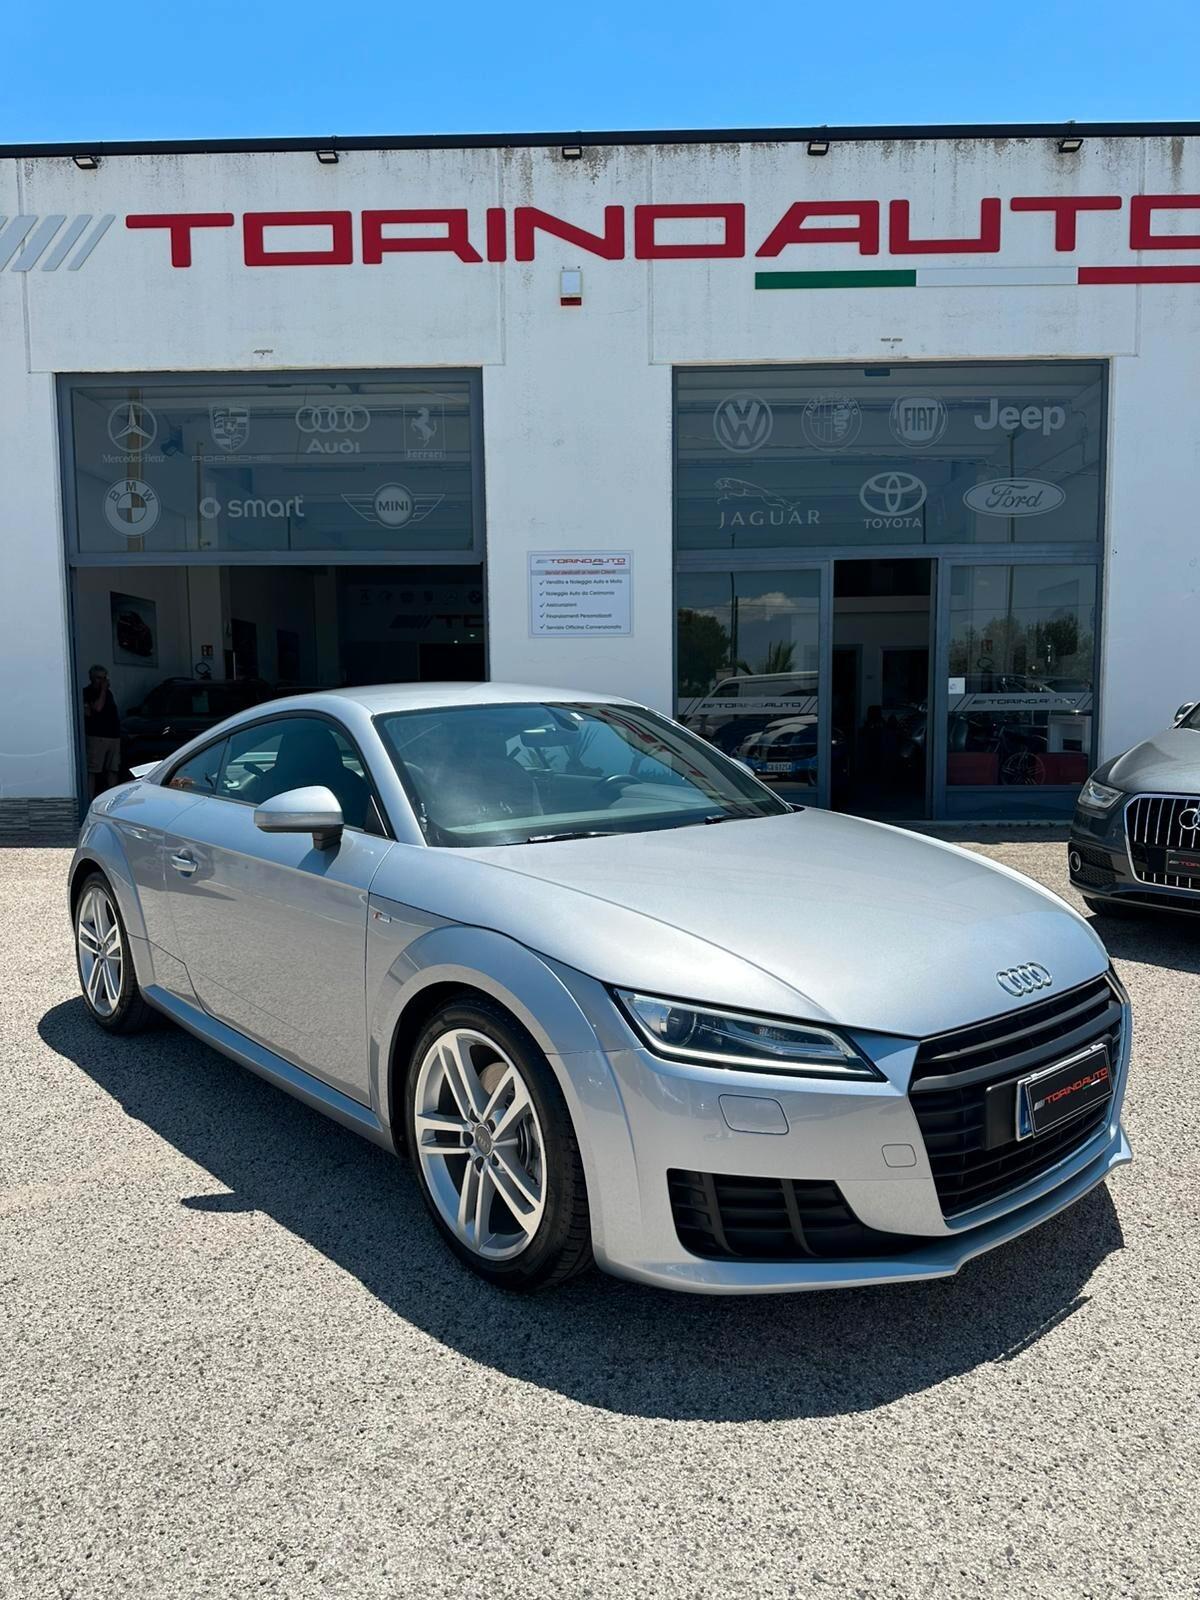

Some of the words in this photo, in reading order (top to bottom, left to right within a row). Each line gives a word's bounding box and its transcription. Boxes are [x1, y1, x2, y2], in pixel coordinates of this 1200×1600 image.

[125, 194, 1200, 268] TORINOAUTO
[903, 406, 936, 432] FIAT
[974, 398, 1066, 436] Jeep
[306, 438, 361, 454] Audi
[407, 448, 443, 459] Ferrari
[191, 455, 273, 464] PORSCHE
[109, 481, 155, 504] BMW
[984, 483, 1044, 510] Ford
[227, 495, 305, 518] smart
[378, 502, 408, 512] MINI
[719, 509, 821, 529] JAGUAR
[863, 517, 922, 529] TOYOTA
[1043, 1067, 1108, 1104] TORINOAUTO
